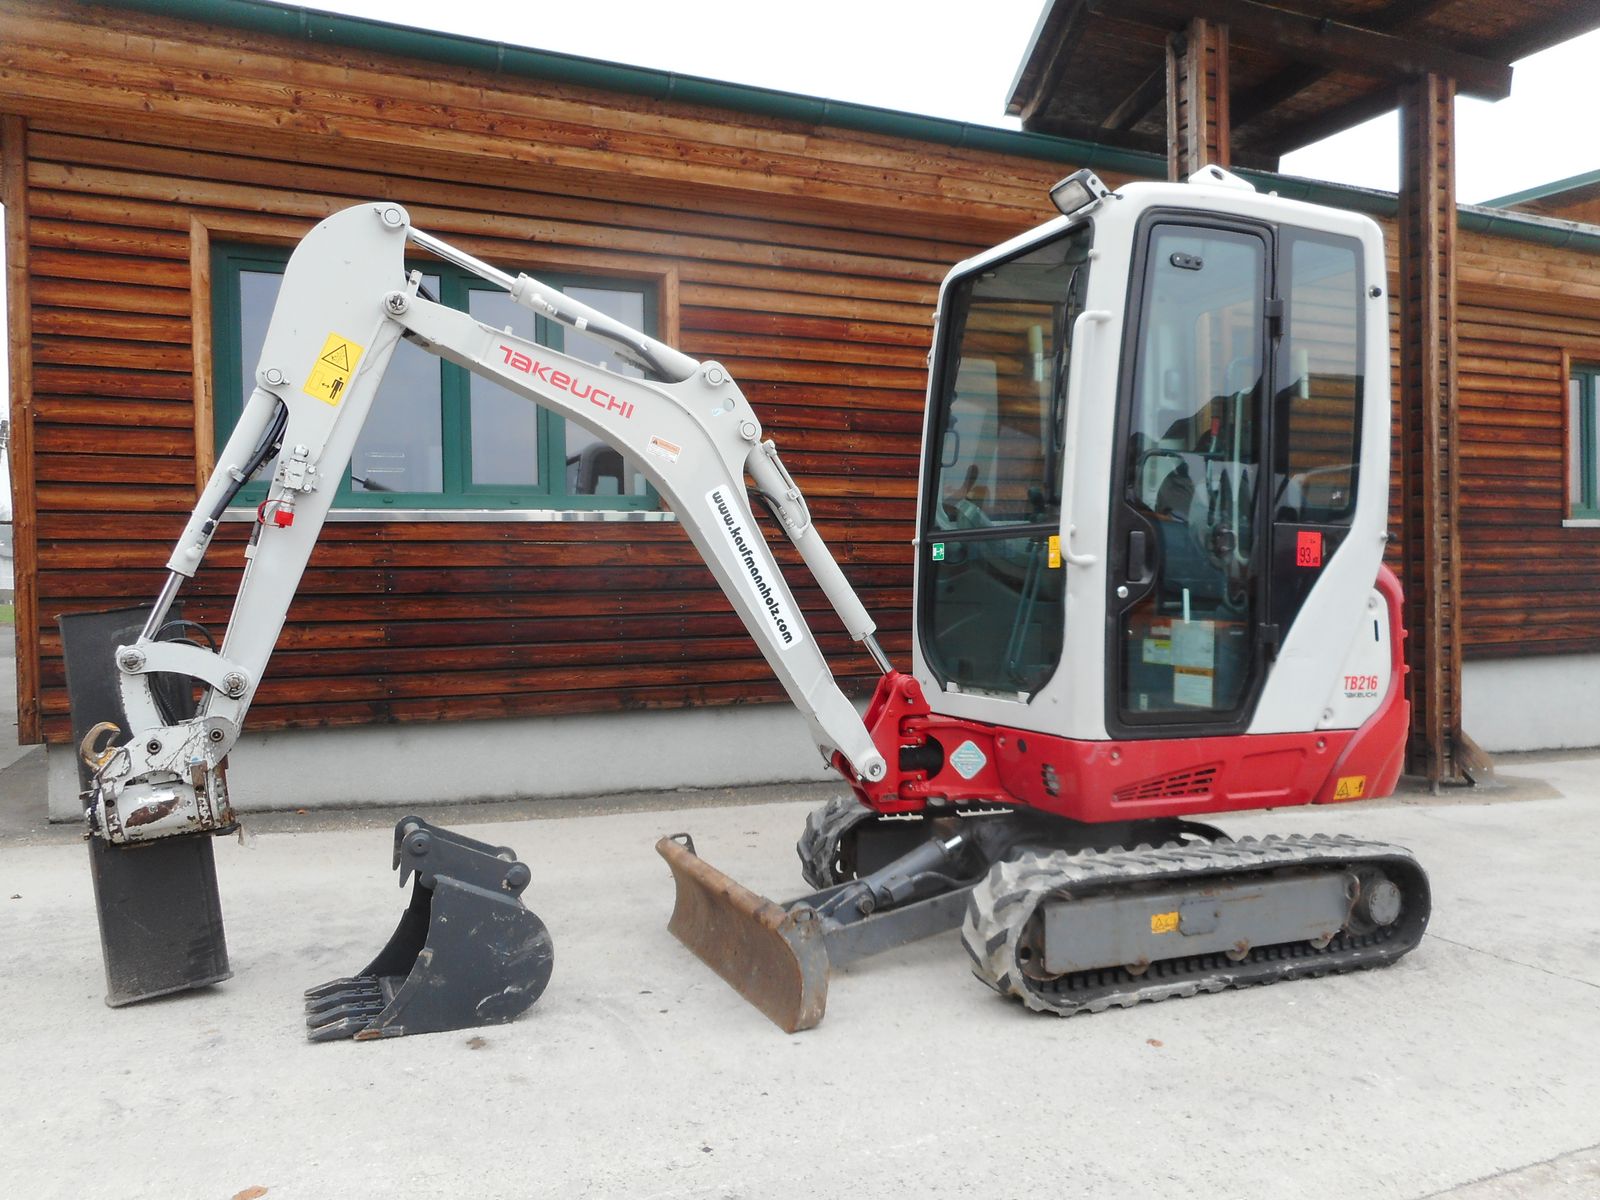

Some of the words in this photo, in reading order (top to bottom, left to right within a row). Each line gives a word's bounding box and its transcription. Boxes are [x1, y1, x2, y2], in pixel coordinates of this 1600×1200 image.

[1300, 546, 1311, 563] 93
[712, 491, 793, 644] www.kaufmannholz.com
[1344, 675, 1378, 690] TB216
